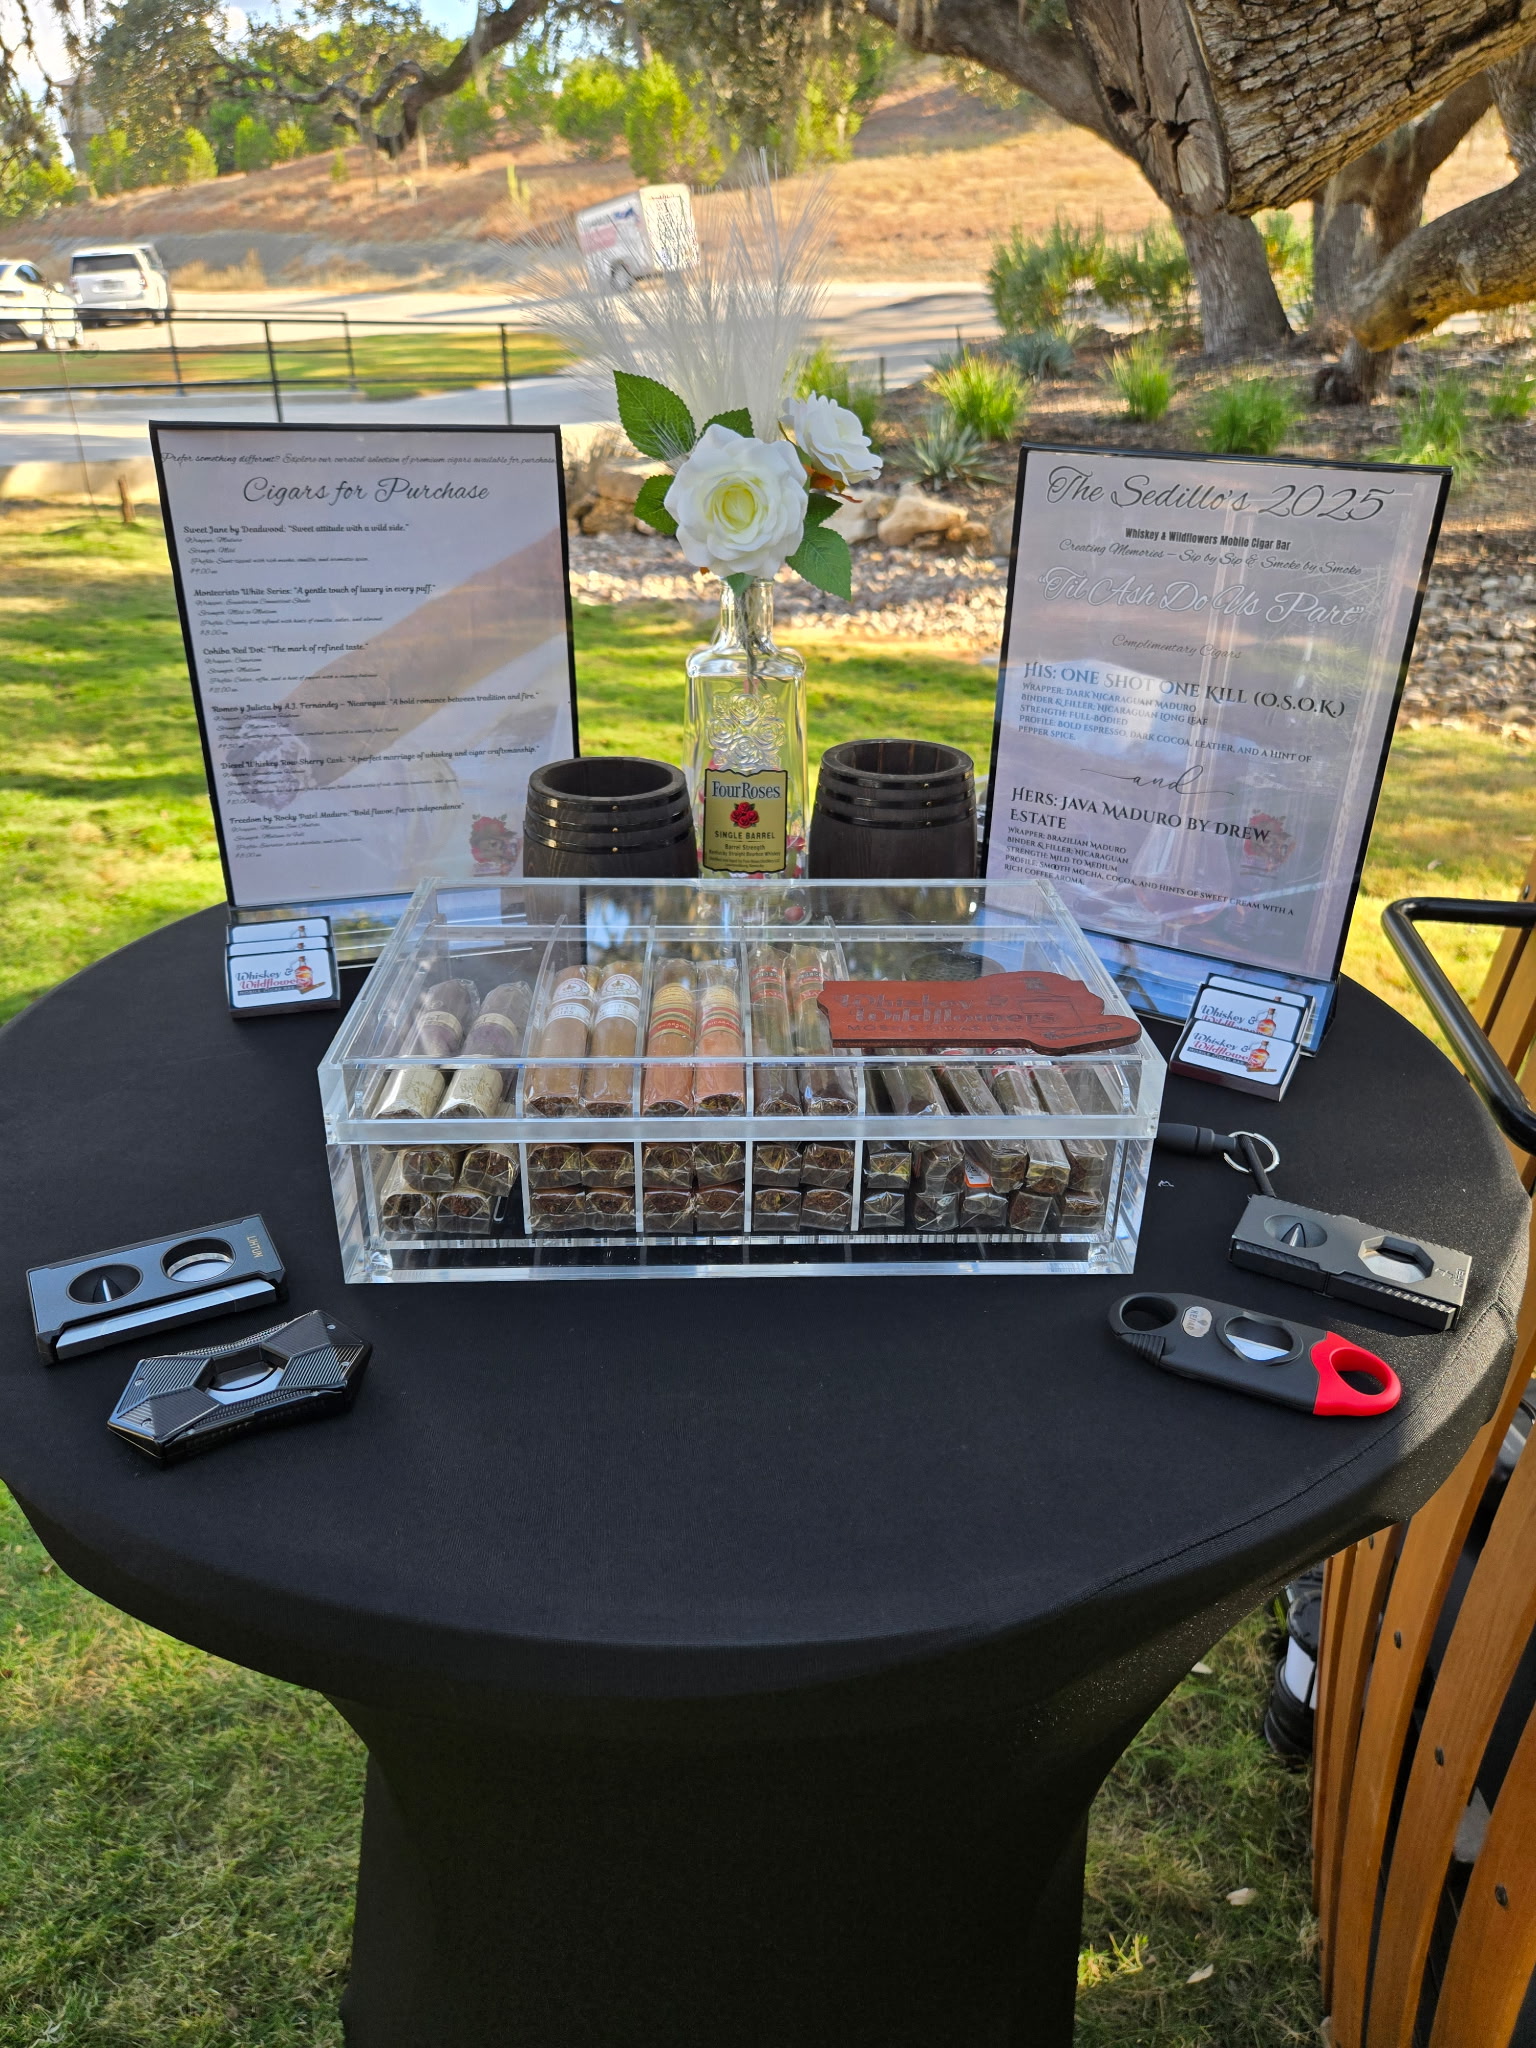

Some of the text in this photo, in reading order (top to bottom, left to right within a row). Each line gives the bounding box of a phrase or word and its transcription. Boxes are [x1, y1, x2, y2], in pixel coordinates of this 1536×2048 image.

[195, 455, 237, 464] something
[239, 454, 280, 464] different?
[283, 453, 317, 463] Explore
[447, 456, 470, 465] cigars
[243, 476, 489, 507] Cigars for Purchase
[1047, 466, 1395, 521] The Sedillo's 2025
[183, 525, 208, 534] Sweet
[208, 525, 229, 534] Jane
[230, 525, 240, 536] by
[240, 525, 286, 533] Deadwood:
[315, 524, 345, 532] attitude
[346, 523, 363, 531] with
[371, 523, 387, 531] wild
[1125, 528, 1291, 551] Whiskey Wildflowers Mobile Cigar Bar
[1059, 538, 1362, 576] Creating Memories Sip by Sip & Smoke by Smoke
[193, 588, 240, 596] Montecristo
[266, 587, 292, 595] Series:
[304, 586, 327, 597] gentle
[328, 586, 349, 594] touch
[360, 585, 384, 596] luxury
[394, 586, 414, 595] every
[415, 584, 436, 595] puff."
[1088, 575, 1155, 606] Ash
[1159, 581, 1209, 612] Do
[1213, 585, 1261, 617] Us
[1266, 591, 1364, 625] Part"
[203, 643, 344, 655] Cohiba Red "The mark refined
[1112, 634, 1242, 660] Complimentary Cigars
[211, 705, 238, 713] Romeo
[246, 704, 272, 712] Julieta
[476, 694, 506, 702] tradition
[507, 692, 520, 700] and
[521, 691, 539, 701] fire."
[1060, 667, 1099, 685] ONE
[1103, 673, 1155, 691] SHOT
[1159, 680, 1200, 698] ONE
[1205, 685, 1248, 704] KILL
[1253, 691, 1345, 719] (O.S.O.K.)
[1066, 688, 1091, 699] DARK
[1091, 690, 1152, 706] NICARAGUAN
[1153, 700, 1197, 713] MADURO
[1021, 693, 1053, 705] BINDER
[1097, 703, 1158, 718] NICARAGUAN
[1160, 713, 1185, 723] LONG
[1187, 716, 1208, 726] LEAF
[1018, 725, 1049, 737] PEPPER
[1057, 720, 1082, 730] BOLD
[1130, 731, 1154, 741] DARK
[1236, 746, 1259, 756] AND
[1270, 750, 1296, 761] HINT
[1298, 754, 1312, 764] OF
[245, 760, 279, 769] Whiskey
[299, 758, 325, 767] Sherry
[357, 754, 383, 764] perfect
[383, 753, 416, 762] marriage
[425, 750, 453, 760] whiskey
[468, 749, 486, 758] cigar
[487, 745, 540, 756] craftsmanship."
[712, 781, 781, 799] Four Roses
[228, 816, 262, 824] Freedom
[273, 814, 297, 822] Rocky
[321, 810, 350, 818] Maduro:
[371, 808, 394, 817] flavor,
[395, 806, 415, 816] fierce
[416, 803, 464, 813] independence"
[1010, 808, 1067, 830] ESTATE
[1060, 796, 1098, 814] JAVA
[1102, 801, 1182, 828] MADURO
[1187, 817, 1211, 833] BY
[1215, 822, 1271, 843] DREW
[714, 830, 775, 839] SINGLE BARREL
[1047, 834, 1088, 847] BRAZILIAN
[1090, 840, 1126, 854] MADURO
[1007, 836, 1035, 848] BINDER
[1075, 848, 1129, 864] NICARAGUAN
[1004, 863, 1054, 879] RICH COFFEE
[1050, 854, 1070, 864] MILD
[1084, 859, 1118, 872] MEDIUM
[1040, 862, 1070, 873] SMOOTH
[1139, 880, 1158, 890] AND
[1159, 884, 1185, 895] HINTS
[1199, 891, 1228, 903] SWEET
[1229, 896, 1260, 909] CREAM
[1262, 903, 1286, 914] WITH
[237, 967, 294, 981] Whiskey &
[240, 977, 307, 990] Wildflowers
[1201, 1004, 1245, 1024] Whiskey
[1247, 1016, 1257, 1025] &
[1193, 1032, 1251, 1053] Whiskey &
[1193, 1040, 1258, 1065] Wildflowers
